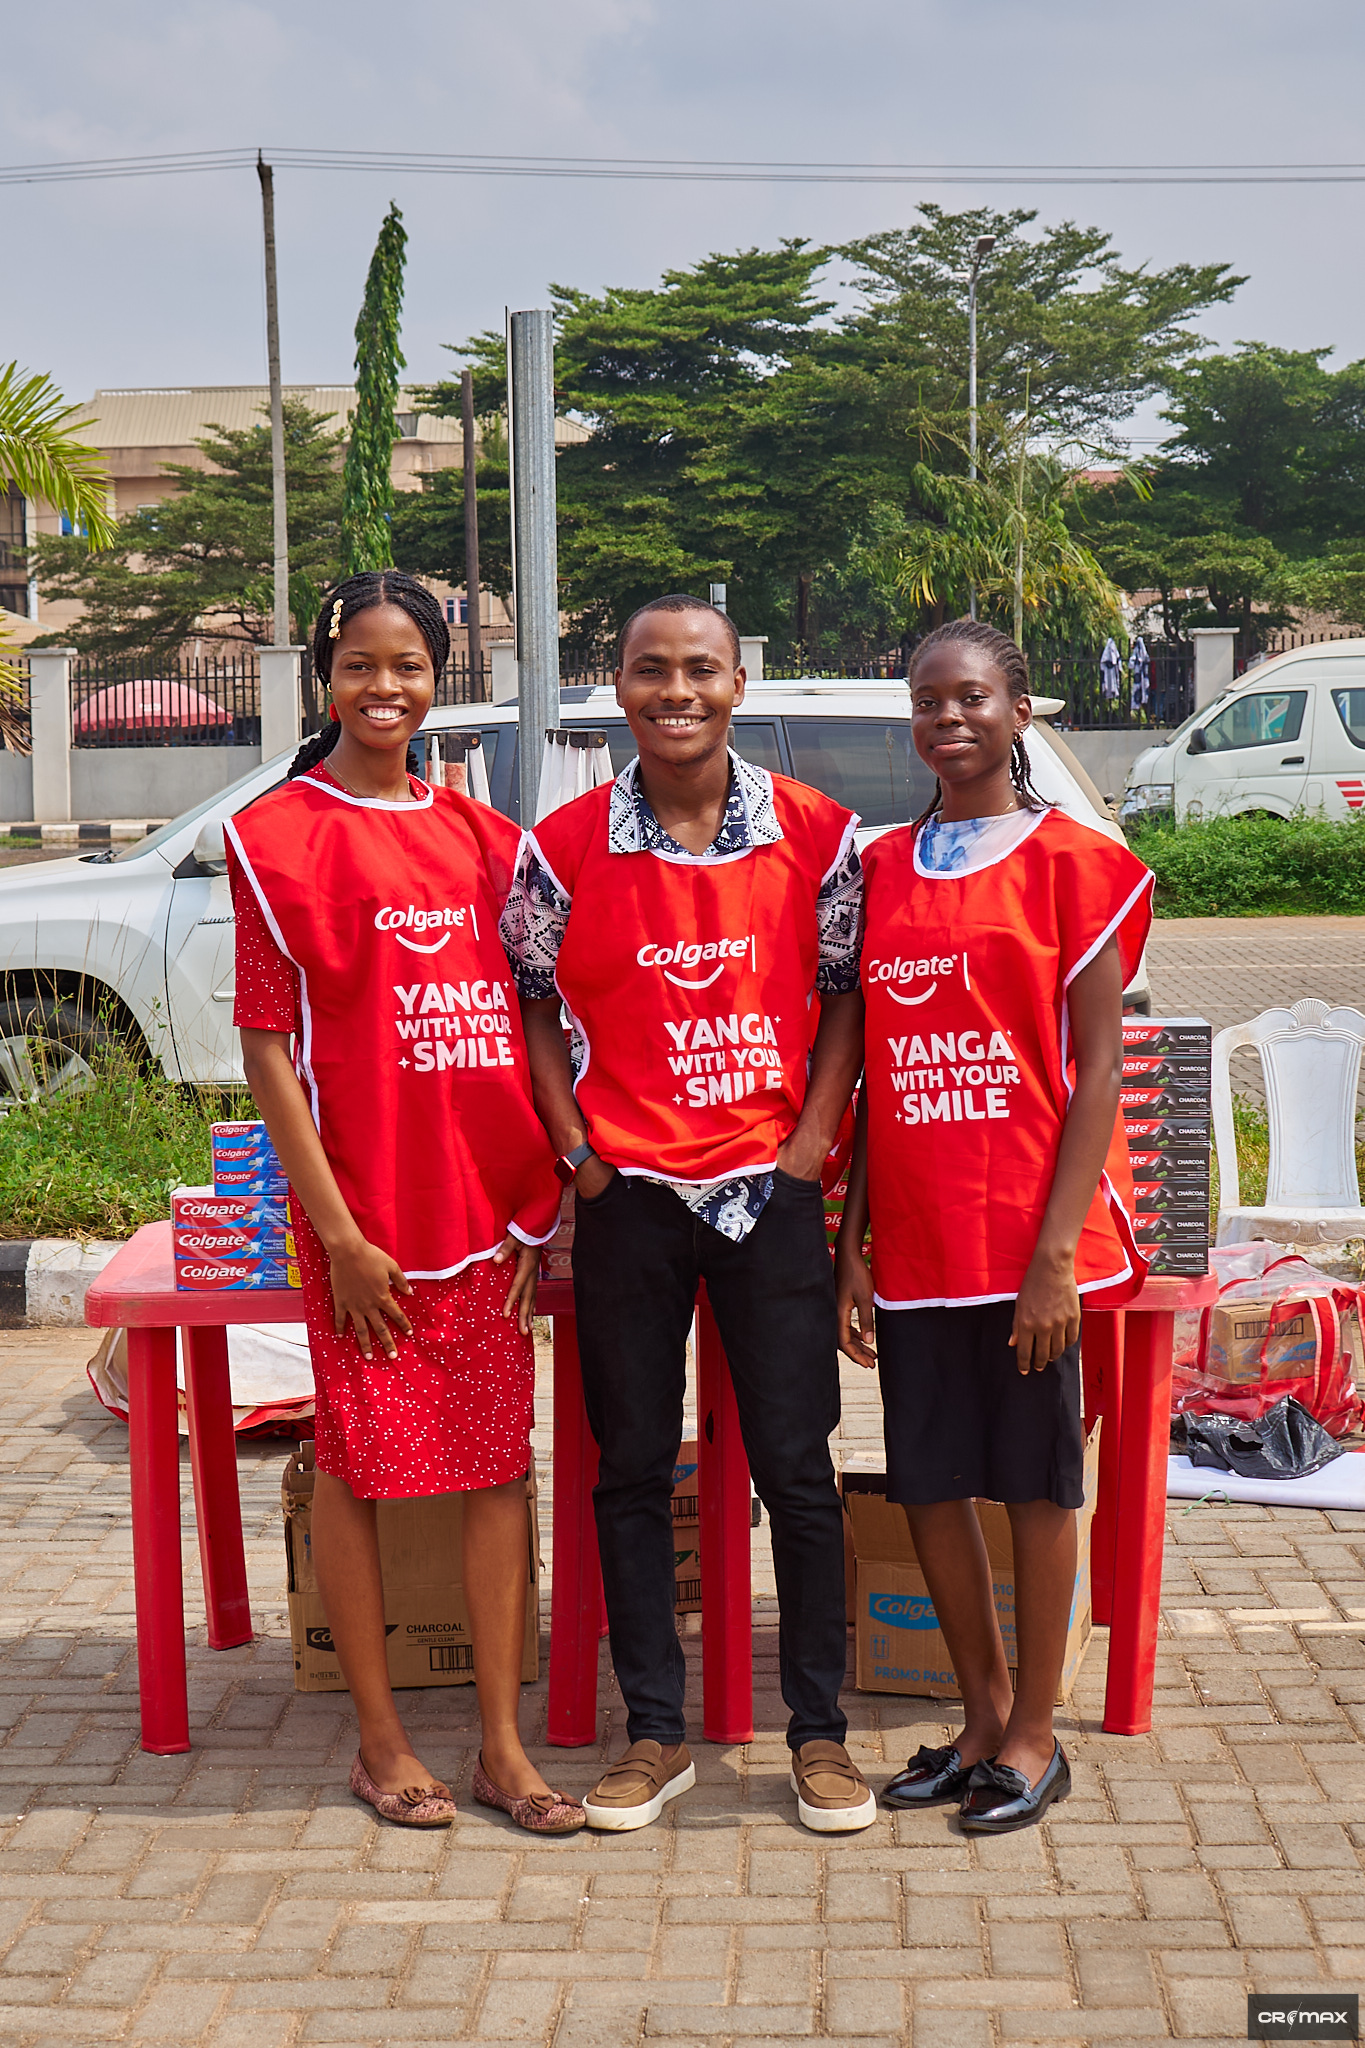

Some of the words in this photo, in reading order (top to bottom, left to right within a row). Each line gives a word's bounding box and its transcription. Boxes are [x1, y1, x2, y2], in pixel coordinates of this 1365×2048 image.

[374, 905, 466, 932] Colgate
[636, 937, 748, 968] Colgate
[868, 955, 955, 984] Colgate
[393, 980, 509, 1015] YANGA
[395, 1016, 462, 1039] WITH
[464, 1014, 512, 1034] YOUR
[663, 1013, 778, 1051] YANGA
[1121, 1031, 1148, 1040] gate
[413, 1036, 514, 1072] SMILE
[887, 1030, 1016, 1067] YANGA
[667, 1051, 726, 1076] WITH
[730, 1048, 783, 1069] YOUR
[1121, 1062, 1148, 1071] gate
[685, 1070, 783, 1108] SMILE
[890, 1068, 945, 1092] WITH
[949, 1065, 1021, 1086] YOUR
[903, 1087, 1010, 1125] SMILE
[1119, 1093, 1148, 1103] gate
[214, 1126, 249, 1135] Colgate
[216, 1149, 251, 1158] Colgate
[216, 1173, 251, 1182] Colgate
[179, 1203, 246, 1218] Colgate
[178, 1234, 245, 1249] Colgate
[180, 1265, 247, 1280] Colgate
[874, 1597, 937, 1620] Colga
[406, 1622, 465, 1634] CHARCOAL
[874, 1665, 920, 1681] PROMO
[923, 1669, 956, 1685] PACK
